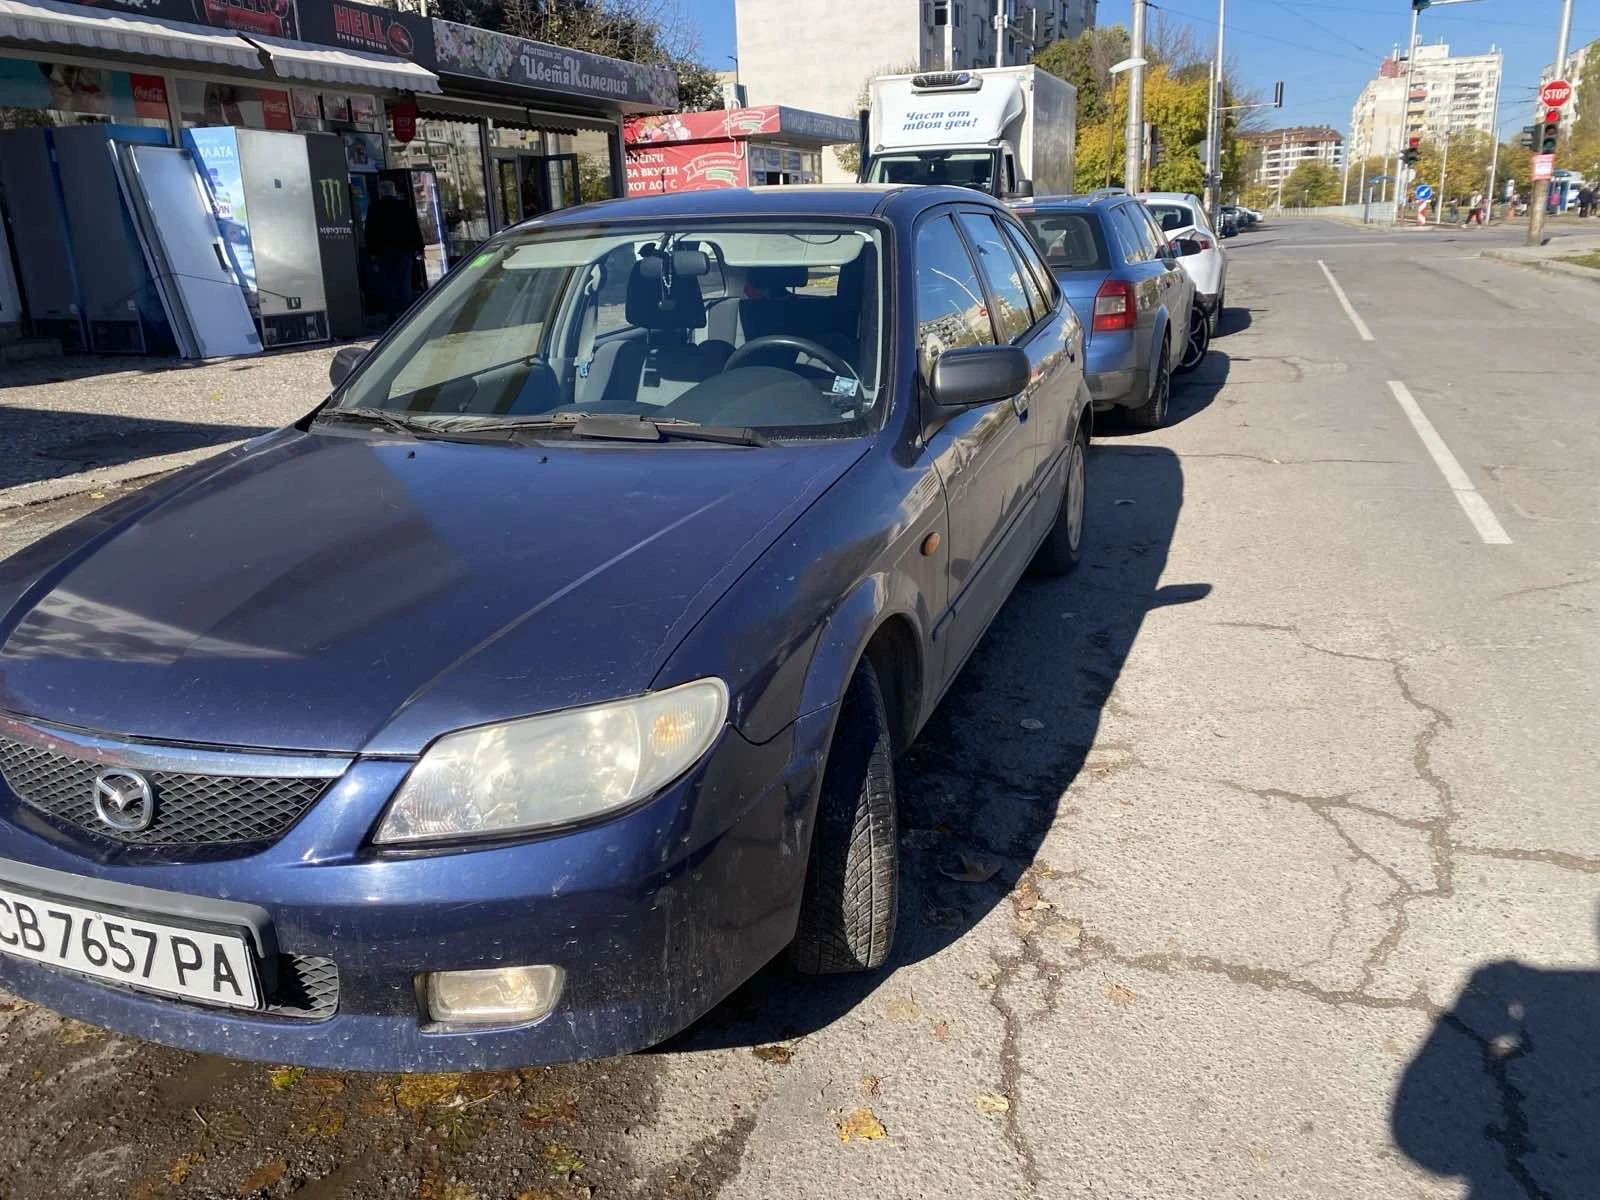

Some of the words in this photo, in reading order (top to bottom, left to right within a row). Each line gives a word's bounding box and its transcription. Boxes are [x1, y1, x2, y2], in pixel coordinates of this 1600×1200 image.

[333, 4, 387, 43] HELL
[1543, 88, 1570, 100] STOP
[906, 111, 944, 121] Част
[948, 110, 971, 119] от
[903, 120, 942, 131] твоя
[944, 118, 979, 131] ден!
[626, 168, 639, 178] ЗА
[641, 165, 678, 177] ВКУСЕН
[627, 181, 646, 192] ХОТ
[648, 179, 668, 191] ДОГ
